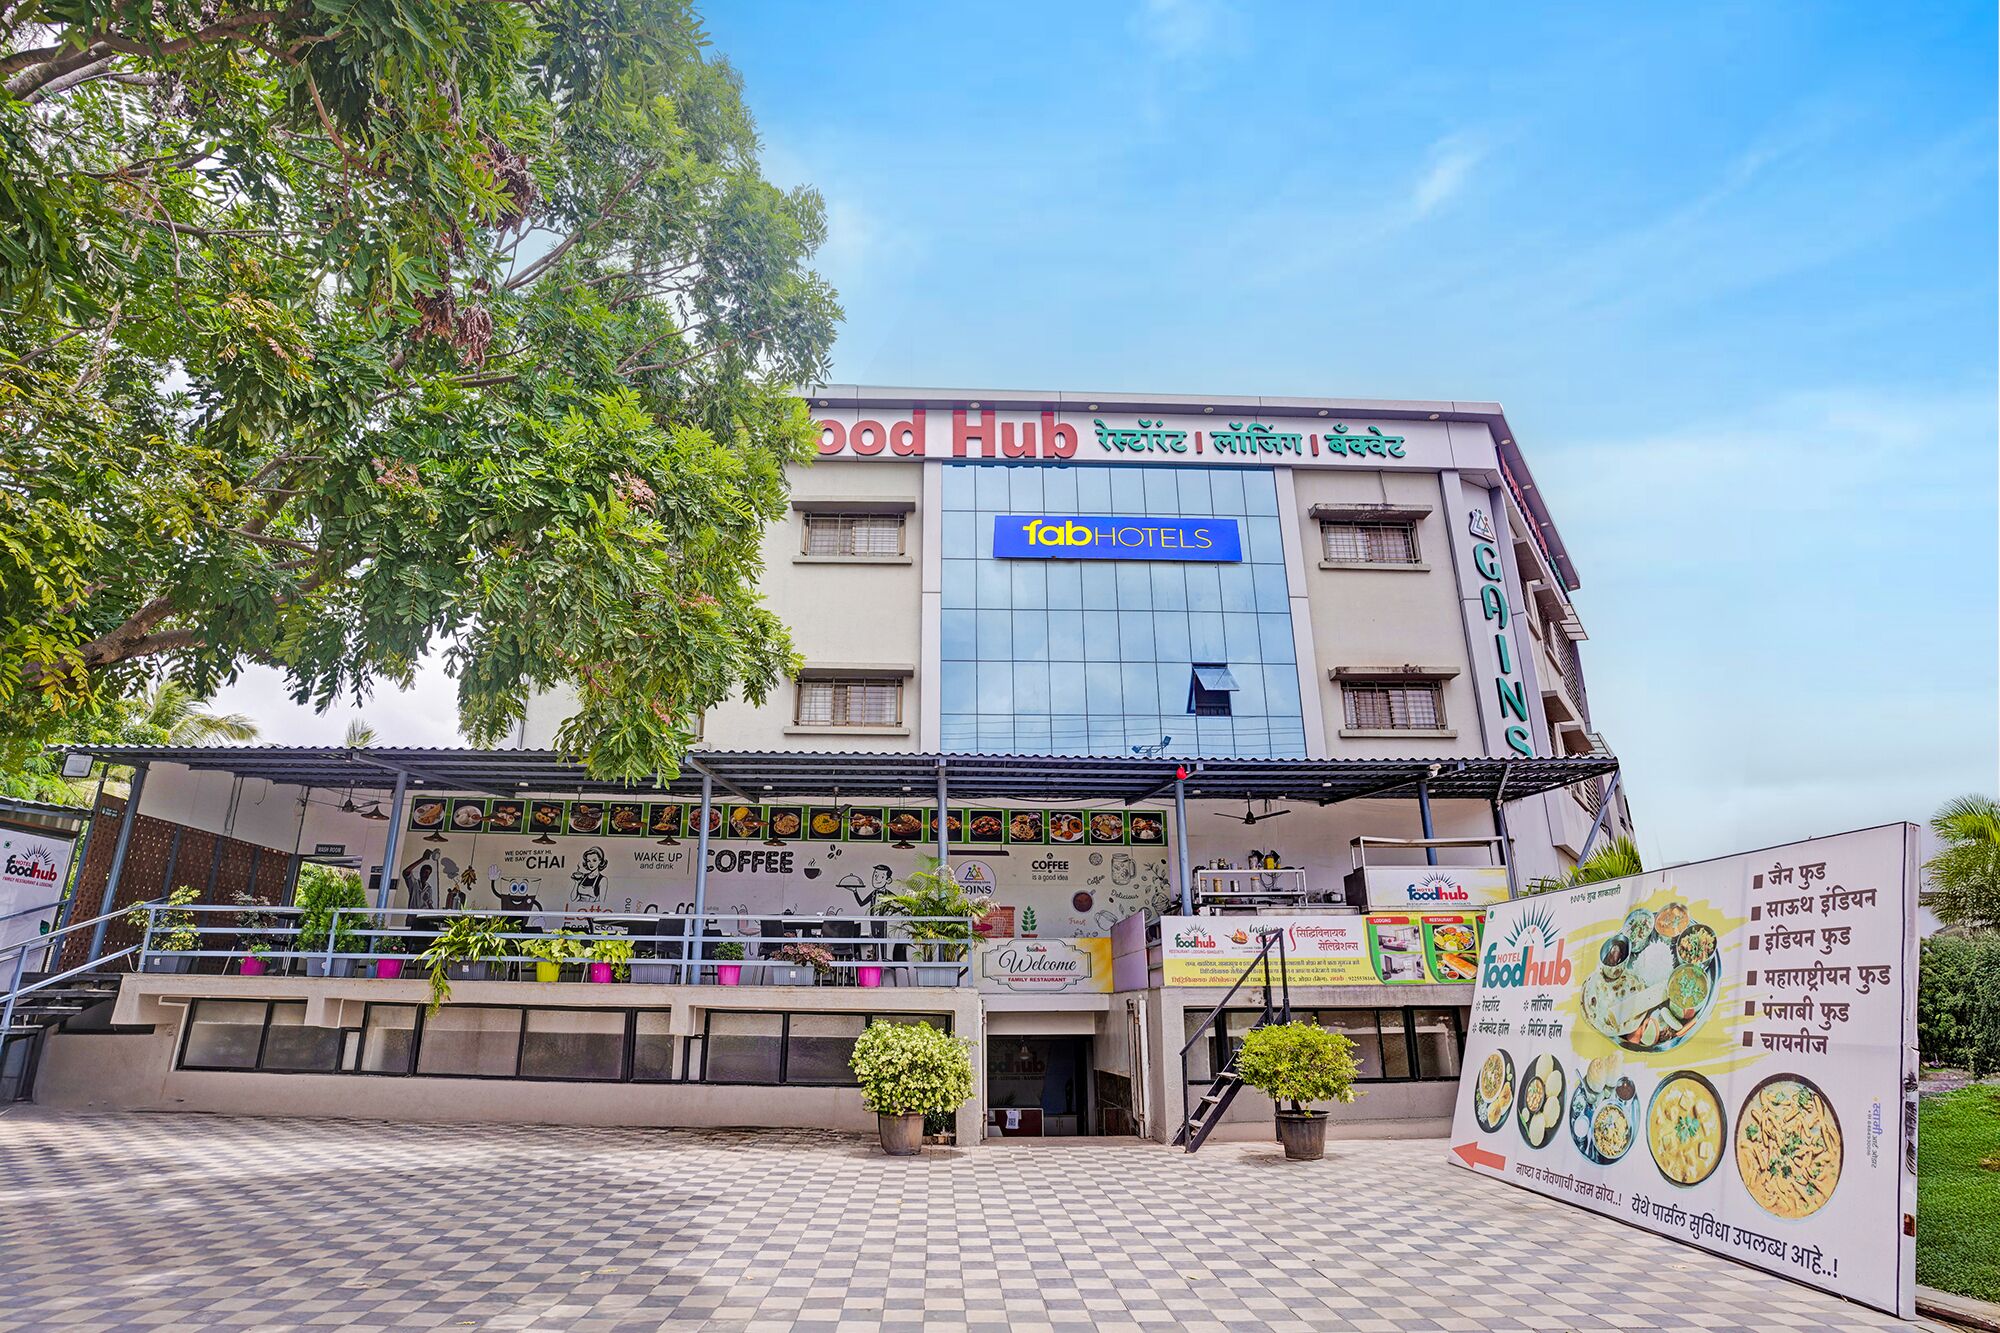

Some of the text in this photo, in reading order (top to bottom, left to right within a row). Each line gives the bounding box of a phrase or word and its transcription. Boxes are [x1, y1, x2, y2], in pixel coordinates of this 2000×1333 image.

[815, 408, 1078, 458] ood Hub
[1094, 418, 1188, 452] रेस्टॉरंट
[1210, 421, 1302, 456] लॉजिंग
[1022, 519, 1213, 549] fabHOTELS
[5, 854, 57, 881] foodhub
[526, 855, 565, 869] CHAI
[634, 851, 683, 862] WAKE UP
[1031, 860, 1069, 870] COFFEE
[1043, 874, 1056, 882] good
[1768, 861, 1826, 890] जैन फुड
[1406, 884, 1469, 900] foodhub
[1766, 884, 1877, 918] साऊथ इंडियन
[1175, 933, 1216, 948] foodhub
[1764, 924, 1852, 955] इंडियन फुड
[998, 950, 1077, 974] Welcome
[1482, 938, 1571, 988] foodhub
[1497, 952, 1521, 963] HOTEL
[1764, 960, 1892, 994] महाराष्ट्रीयन फुड
[1762, 995, 1850, 1031] पंजाबी फुड
[1760, 1027, 1829, 1055] चायनीज
[1535, 1168, 1542, 1180] व
[1542, 1167, 1574, 1191] जेवणाची
[1574, 1179, 1595, 1197] उत्तम
[1631, 1193, 1650, 1217] येथे
[1652, 1201, 1687, 1227] पार्सल
[1689, 1212, 1730, 1240] सुविधा
[1732, 1226, 1787, 1260] उपलब्ध
